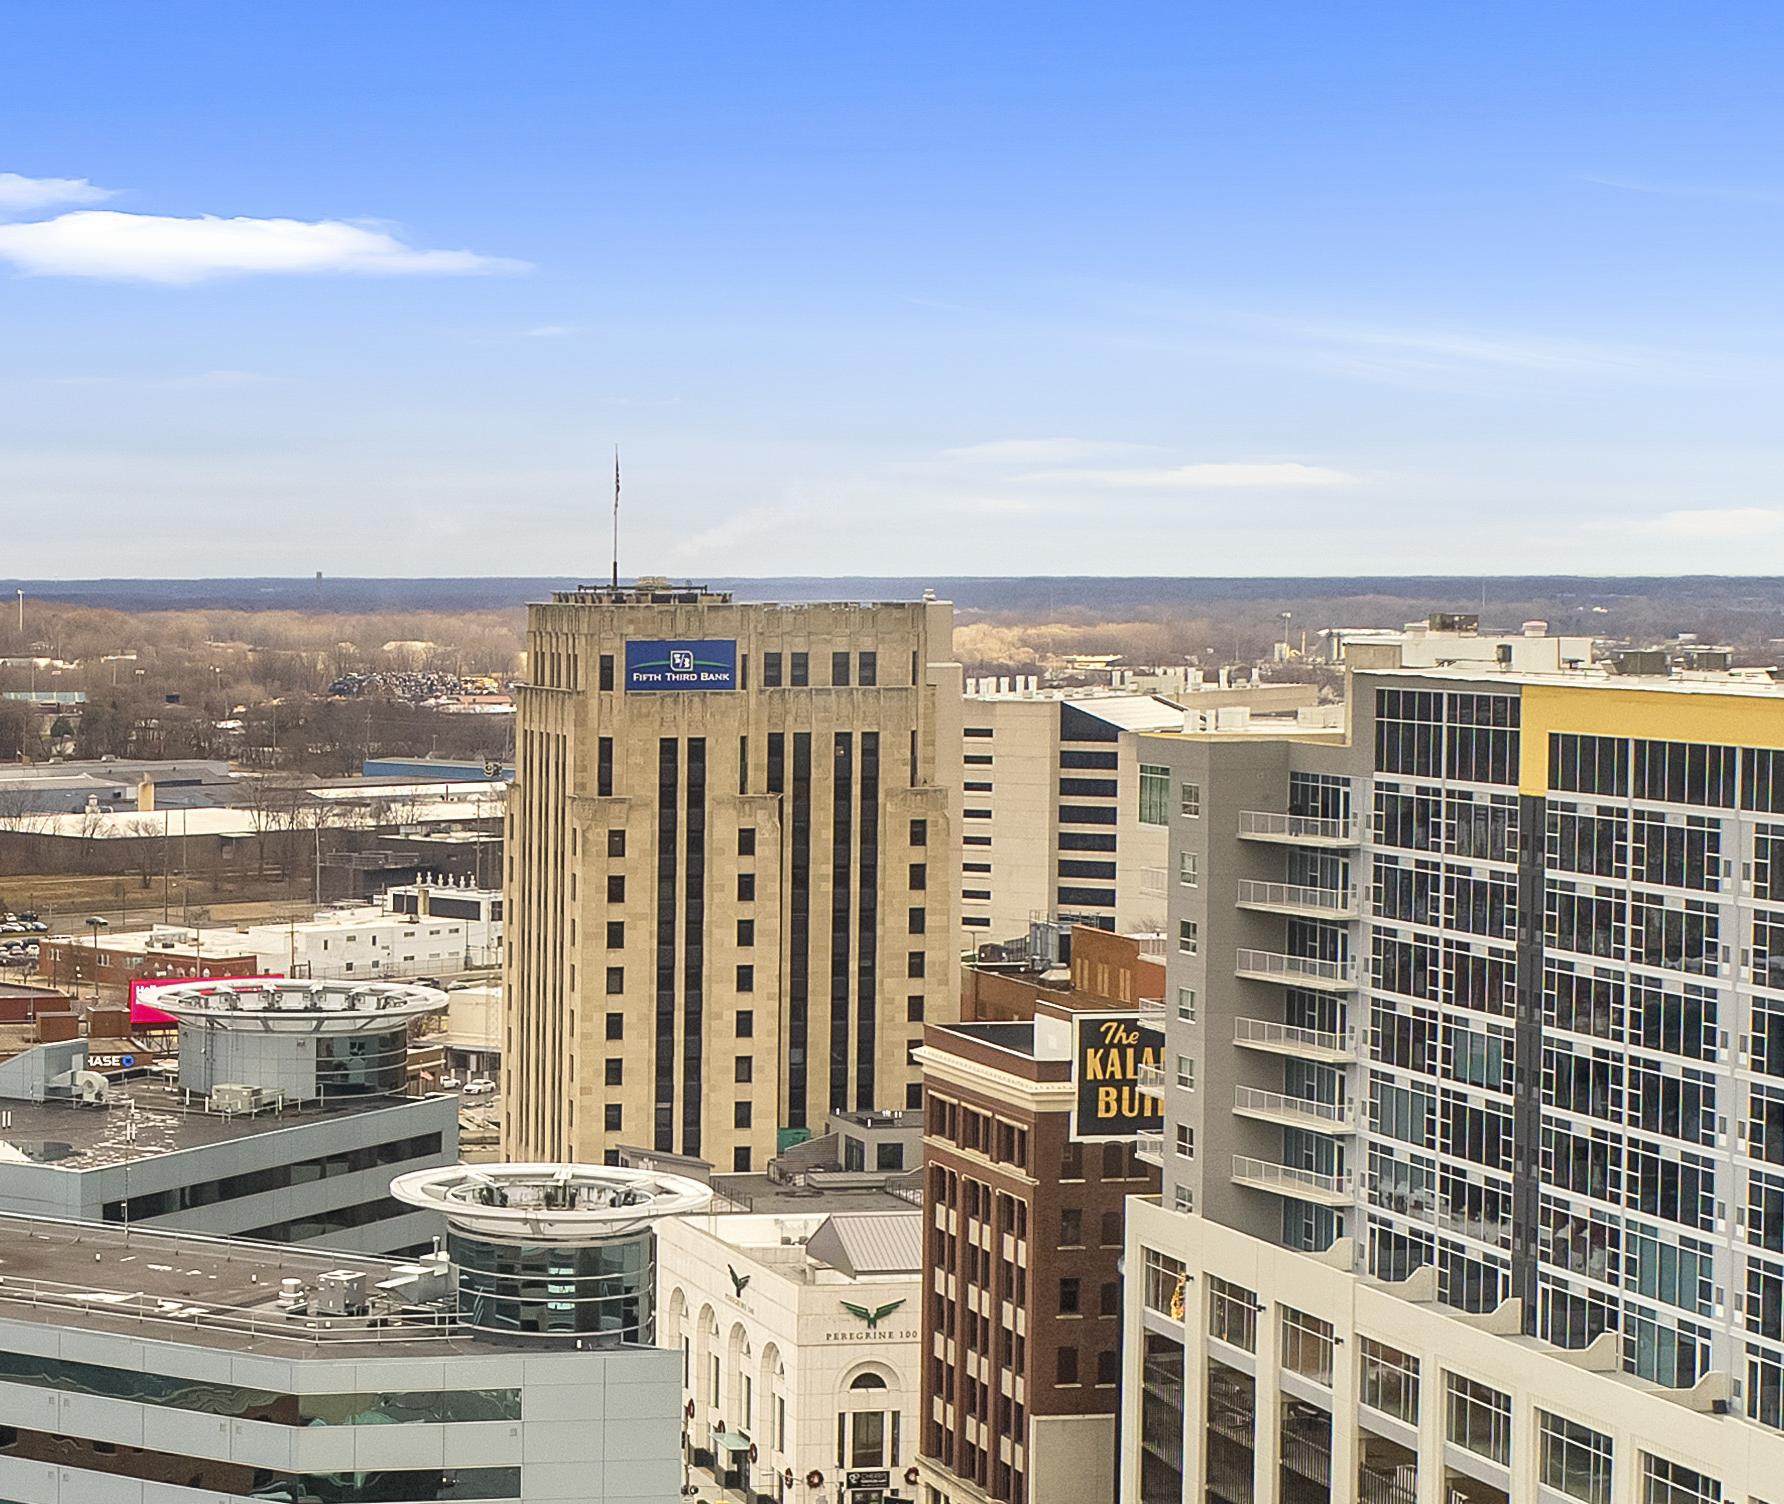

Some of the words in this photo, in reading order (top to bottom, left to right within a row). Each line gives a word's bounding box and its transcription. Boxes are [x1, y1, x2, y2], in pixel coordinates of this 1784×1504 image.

[633, 672, 662, 681] FIFTH
[665, 672, 698, 681] THIRD
[700, 672, 730, 681] BANK
[1100, 1022, 1140, 1045] The
[826, 1331, 894, 1341] PEREGRINE
[899, 1330, 918, 1339] 100
